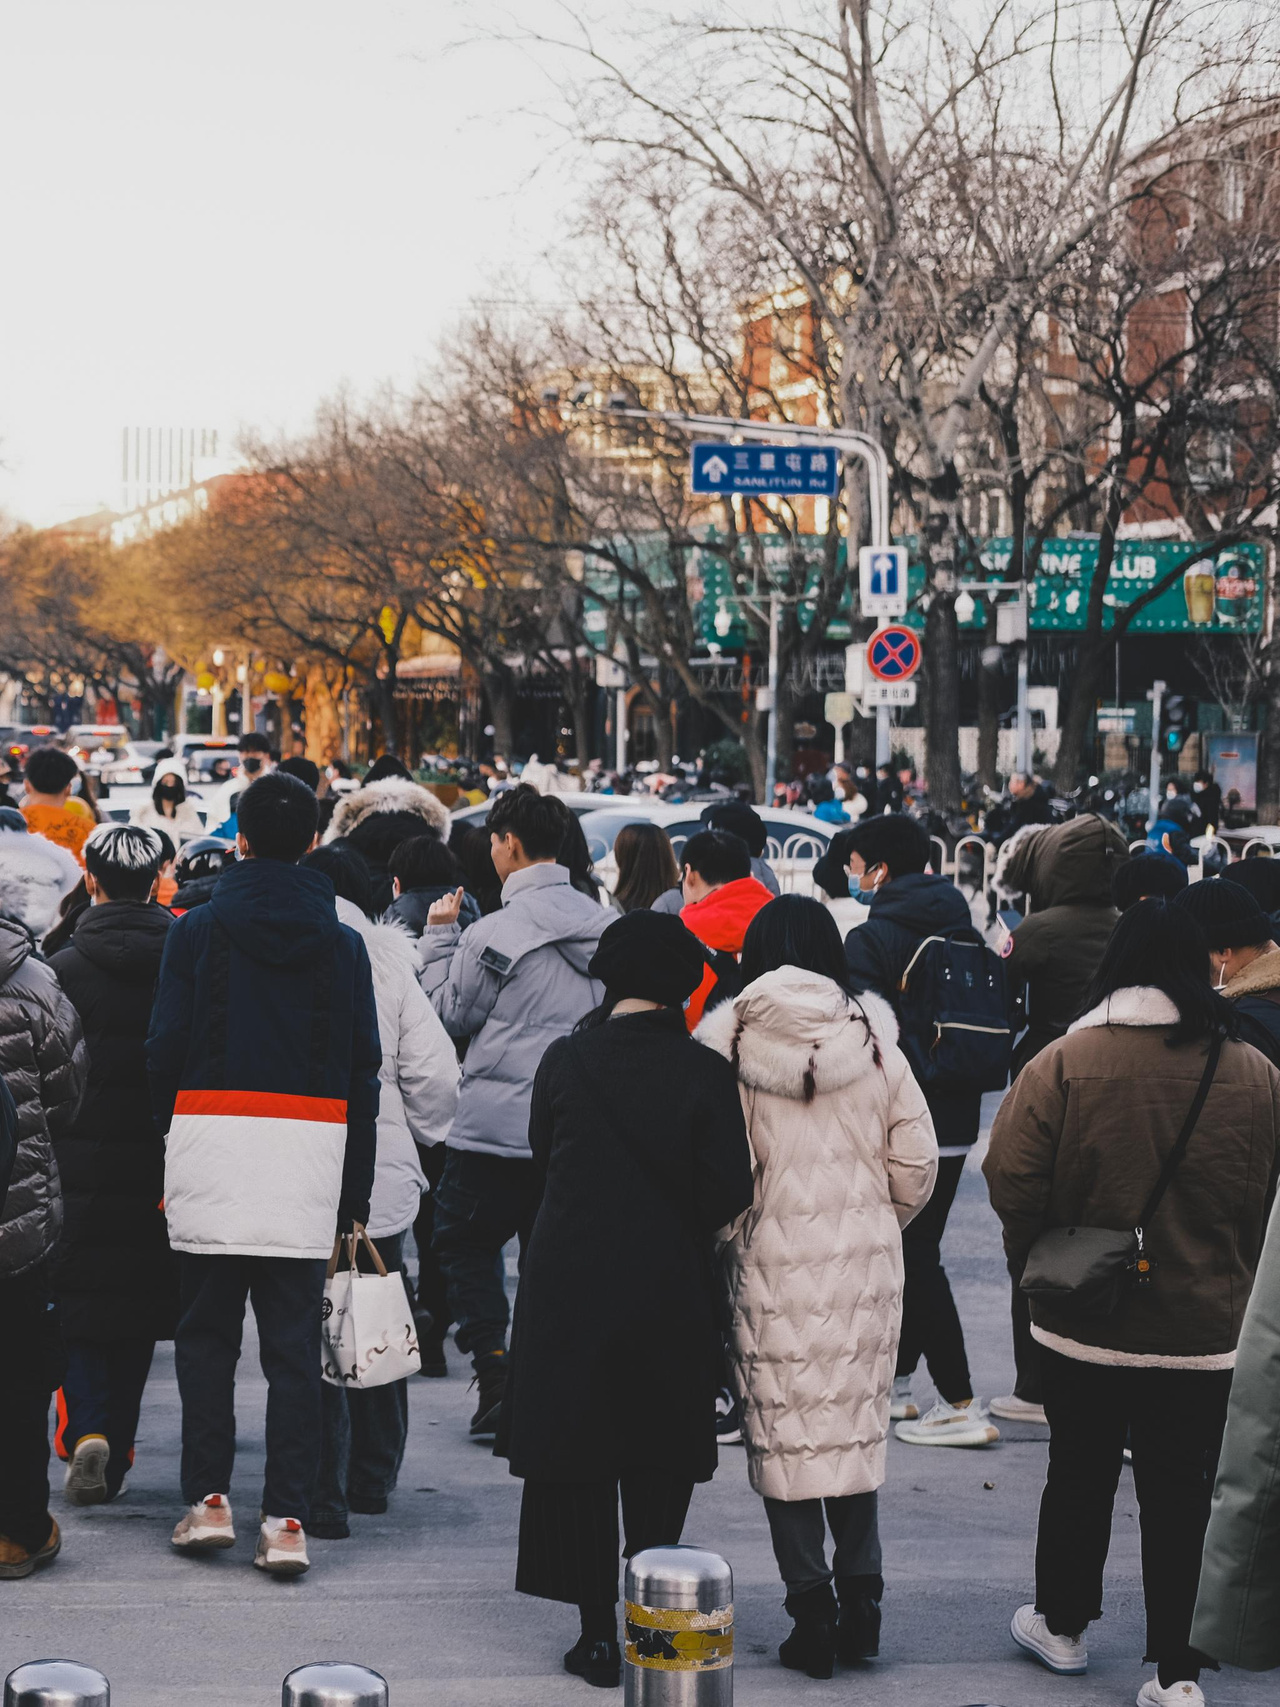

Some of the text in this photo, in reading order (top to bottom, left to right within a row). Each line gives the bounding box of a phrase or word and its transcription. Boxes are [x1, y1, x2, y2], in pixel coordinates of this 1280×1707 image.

[733, 452, 828, 473] 三里屯路
[733, 476, 802, 488] SANLITUN
